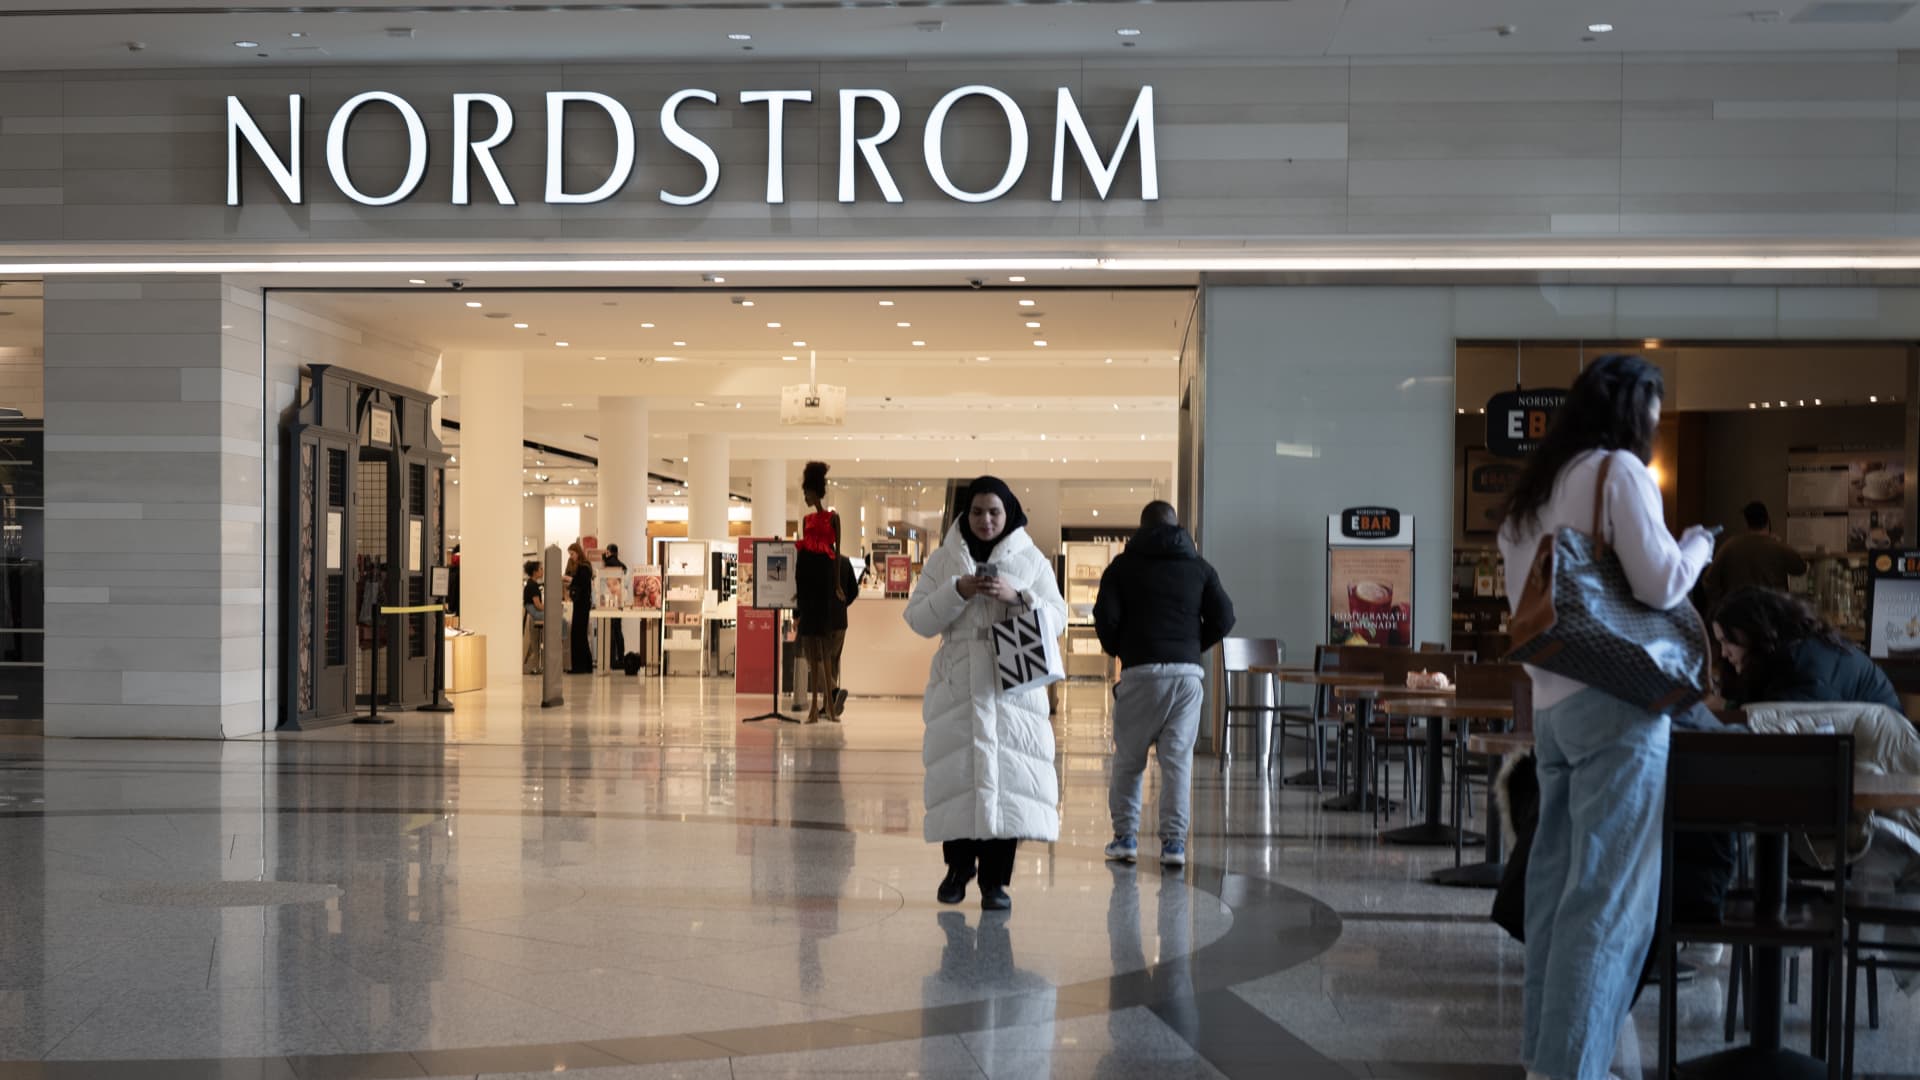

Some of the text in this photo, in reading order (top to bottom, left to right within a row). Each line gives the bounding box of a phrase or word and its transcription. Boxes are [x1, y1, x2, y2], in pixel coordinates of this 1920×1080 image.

[227, 85, 1158, 205] NORDSTROM
[1507, 410, 1546, 438] EB
[1351, 515, 1391, 530] EBAR
[1334, 611, 1408, 620] POMEGRANATE
[1343, 621, 1398, 631] LEMONADE
